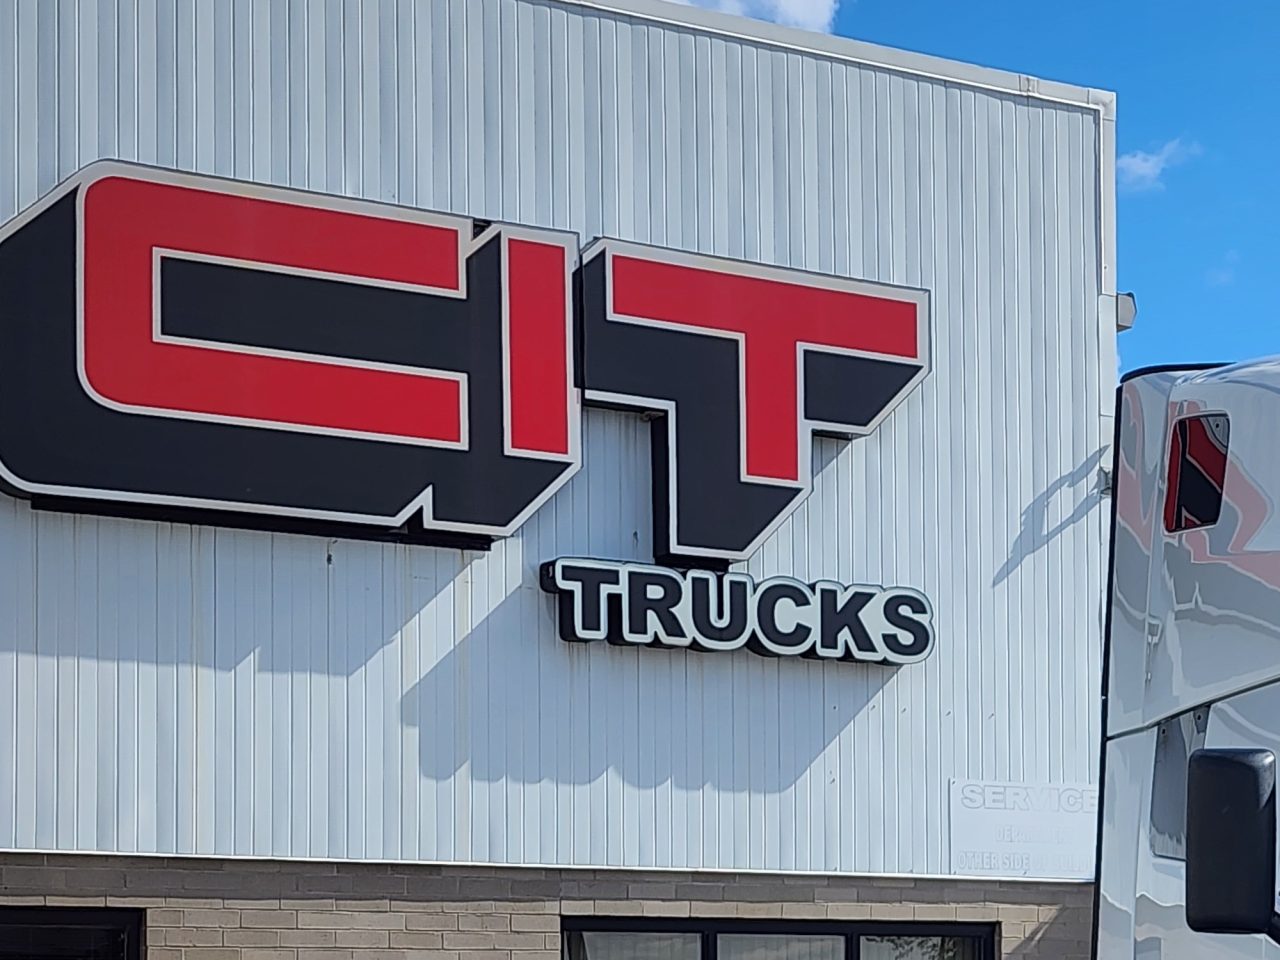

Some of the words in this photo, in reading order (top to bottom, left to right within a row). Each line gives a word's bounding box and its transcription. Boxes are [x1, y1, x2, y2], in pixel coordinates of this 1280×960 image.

[78, 166, 926, 486] CIT
[558, 562, 934, 660] TRUCKS
[961, 784, 1096, 813] SERVICE
[958, 851, 1000, 870] OTHER
[1002, 852, 1030, 871] SIDE
